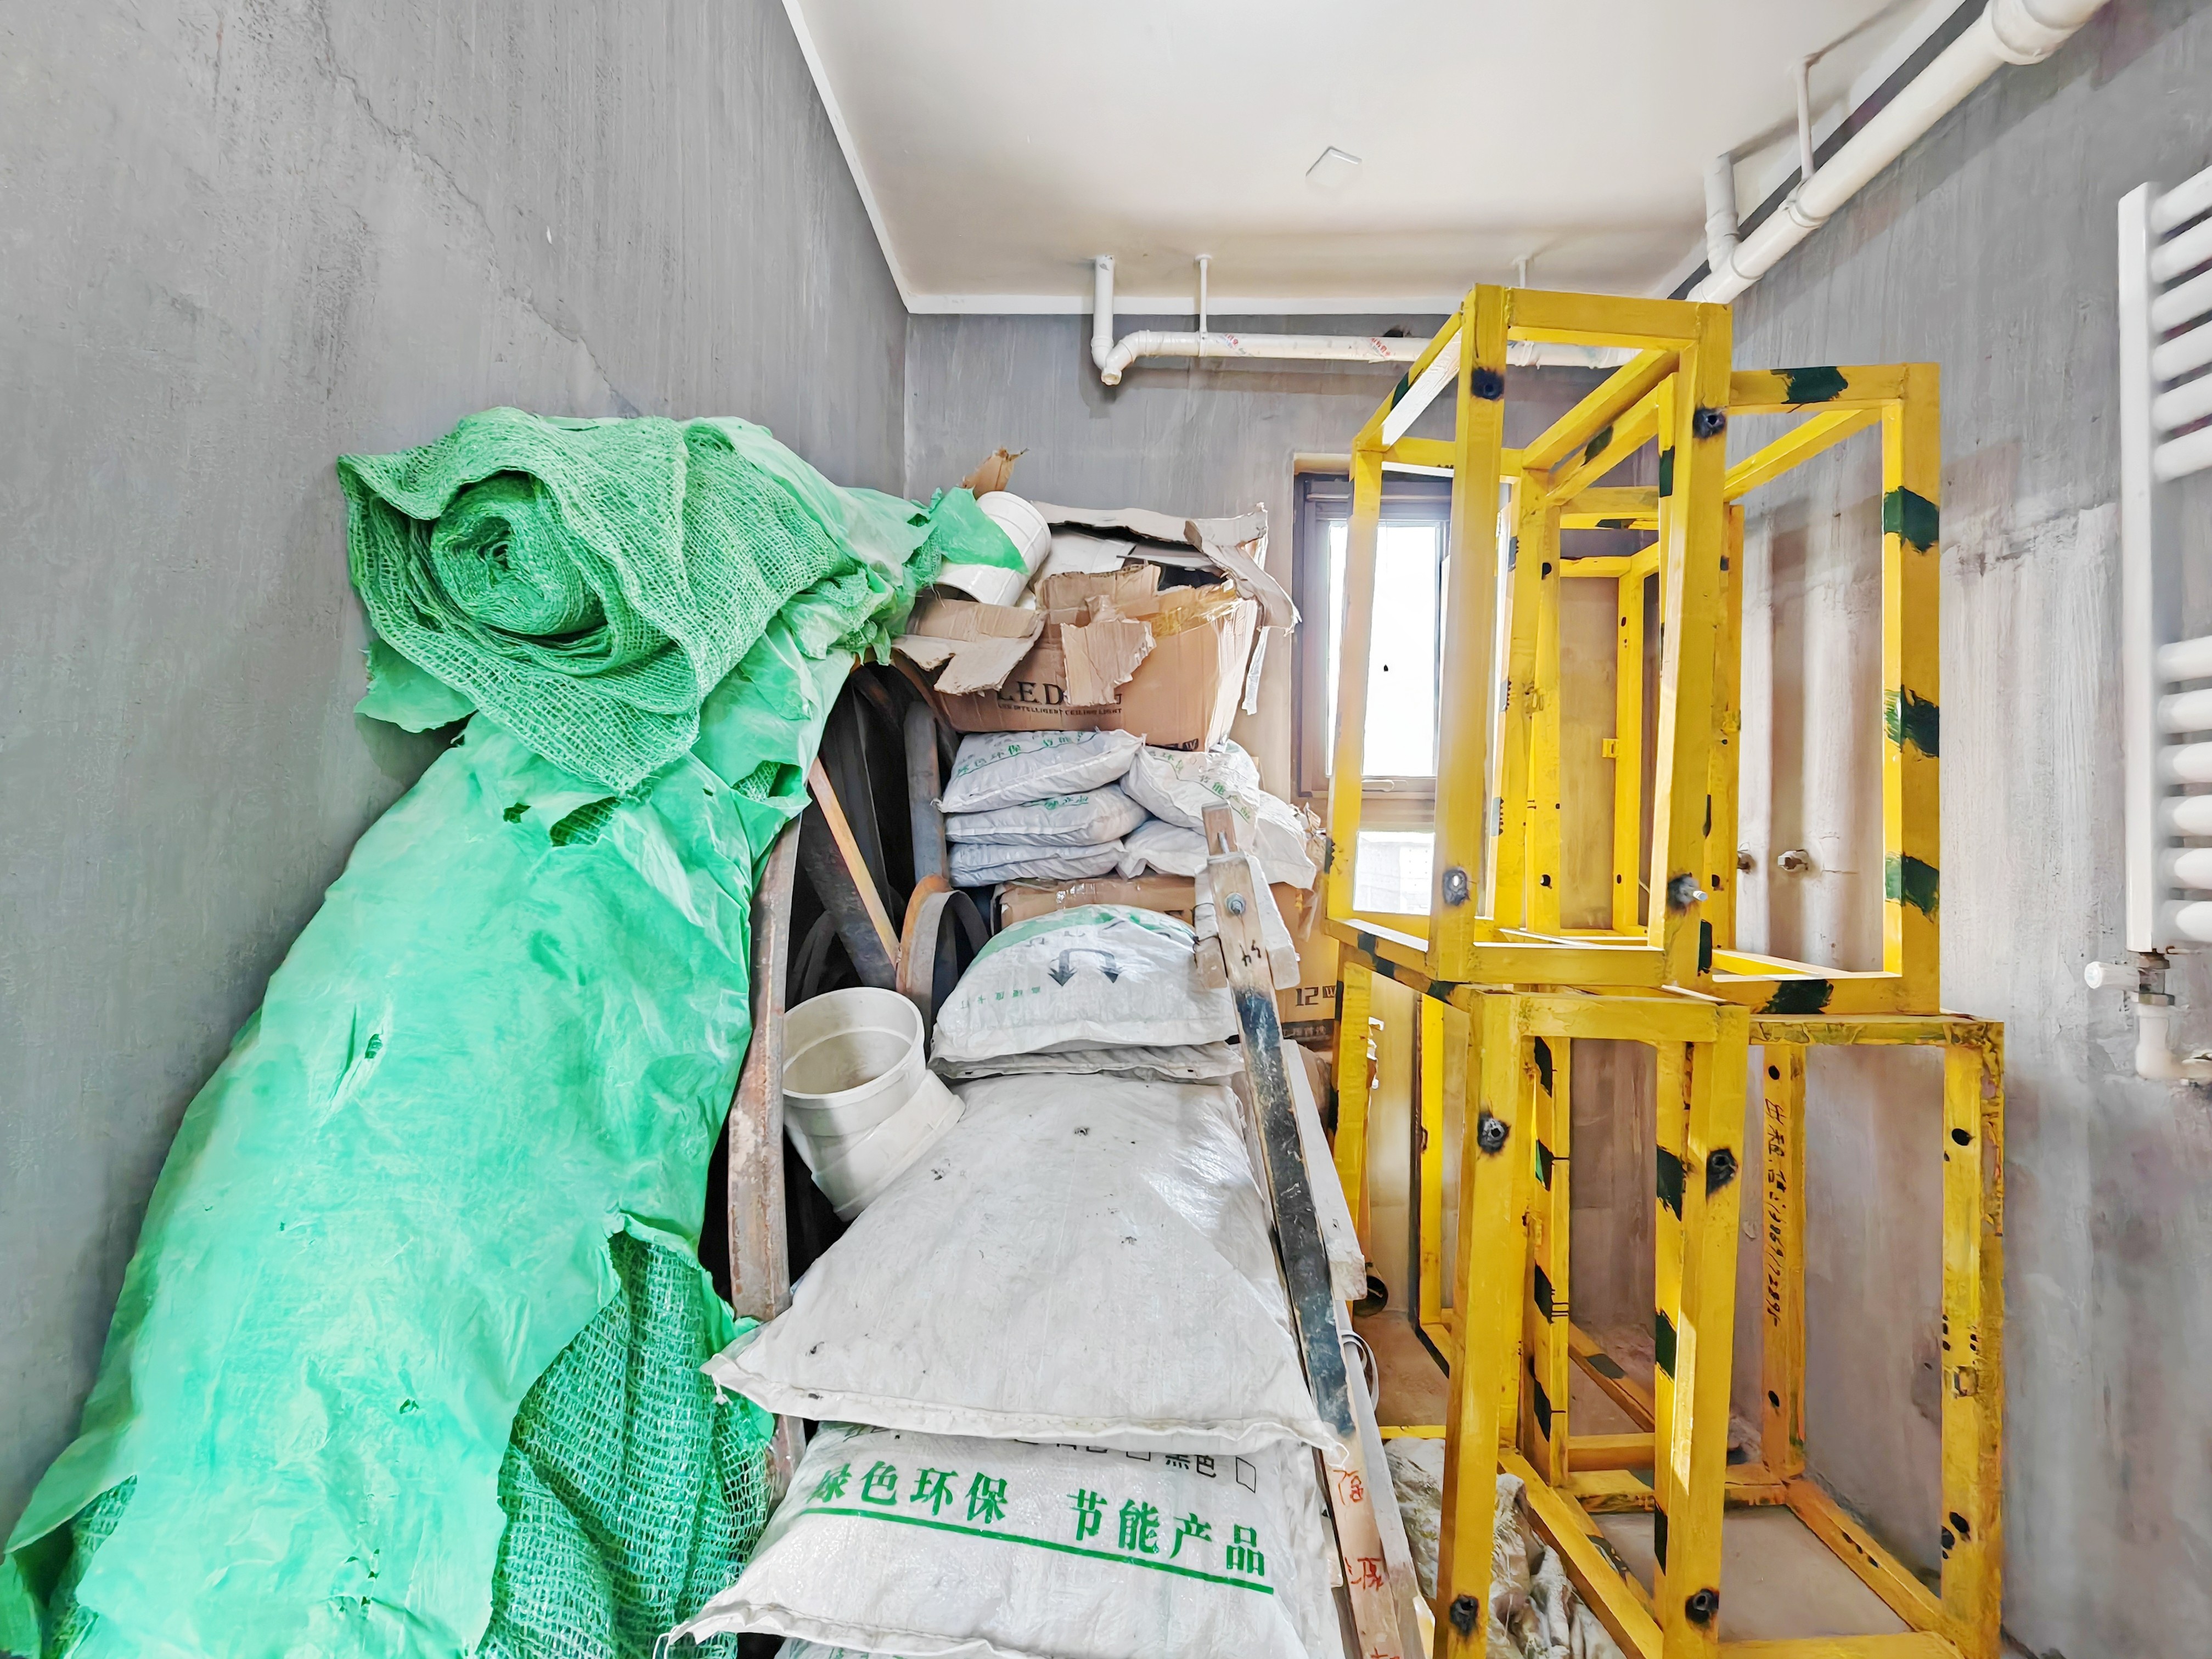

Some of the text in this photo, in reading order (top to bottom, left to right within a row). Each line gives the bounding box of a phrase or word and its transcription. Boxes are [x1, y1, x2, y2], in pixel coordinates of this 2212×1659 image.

[807, 1459, 1267, 1577] 绿色环保 节能产品
